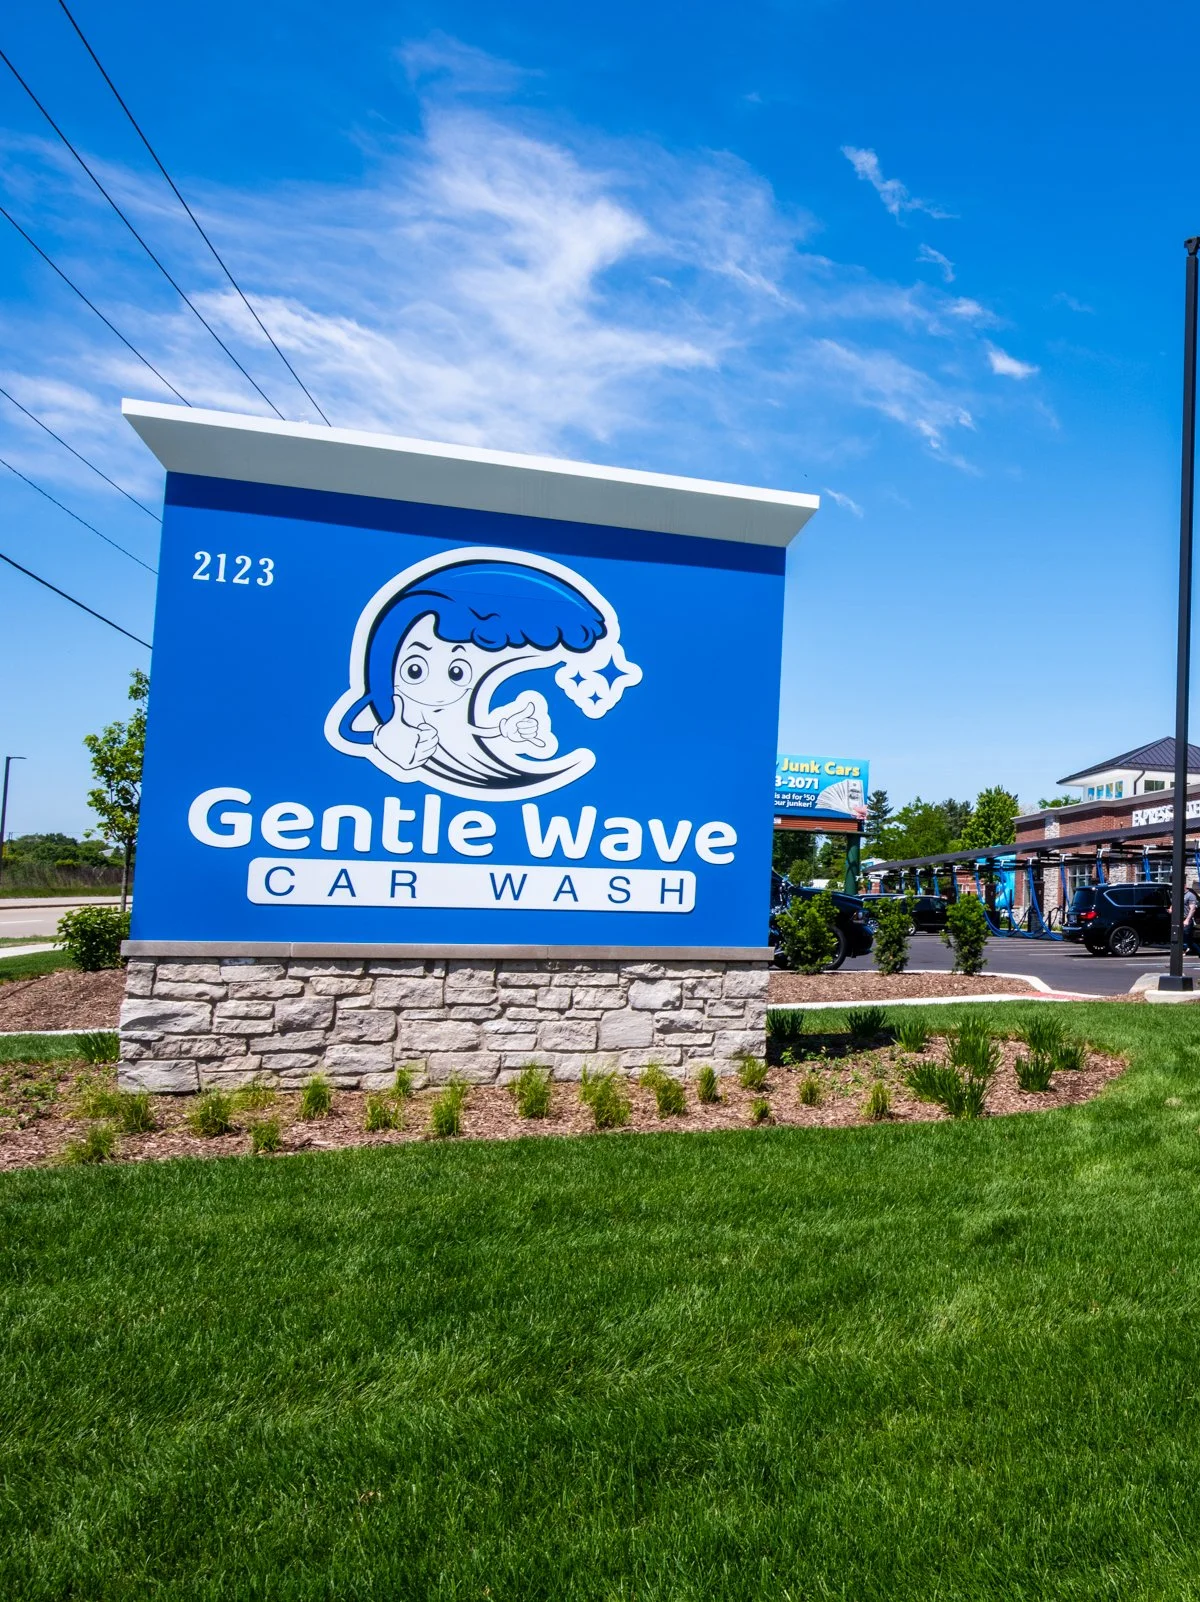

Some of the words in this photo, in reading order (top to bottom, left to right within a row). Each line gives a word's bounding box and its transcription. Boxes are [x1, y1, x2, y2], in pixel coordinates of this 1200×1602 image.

[192, 551, 276, 587] 2123
[781, 758, 820, 774] Junk
[824, 762, 860, 777] Cars
[792, 793, 803, 801] for
[187, 786, 498, 858] Gentle
[521, 802, 739, 866] Wave
[264, 865, 418, 899] CAR
[489, 872, 685, 905] WASH
